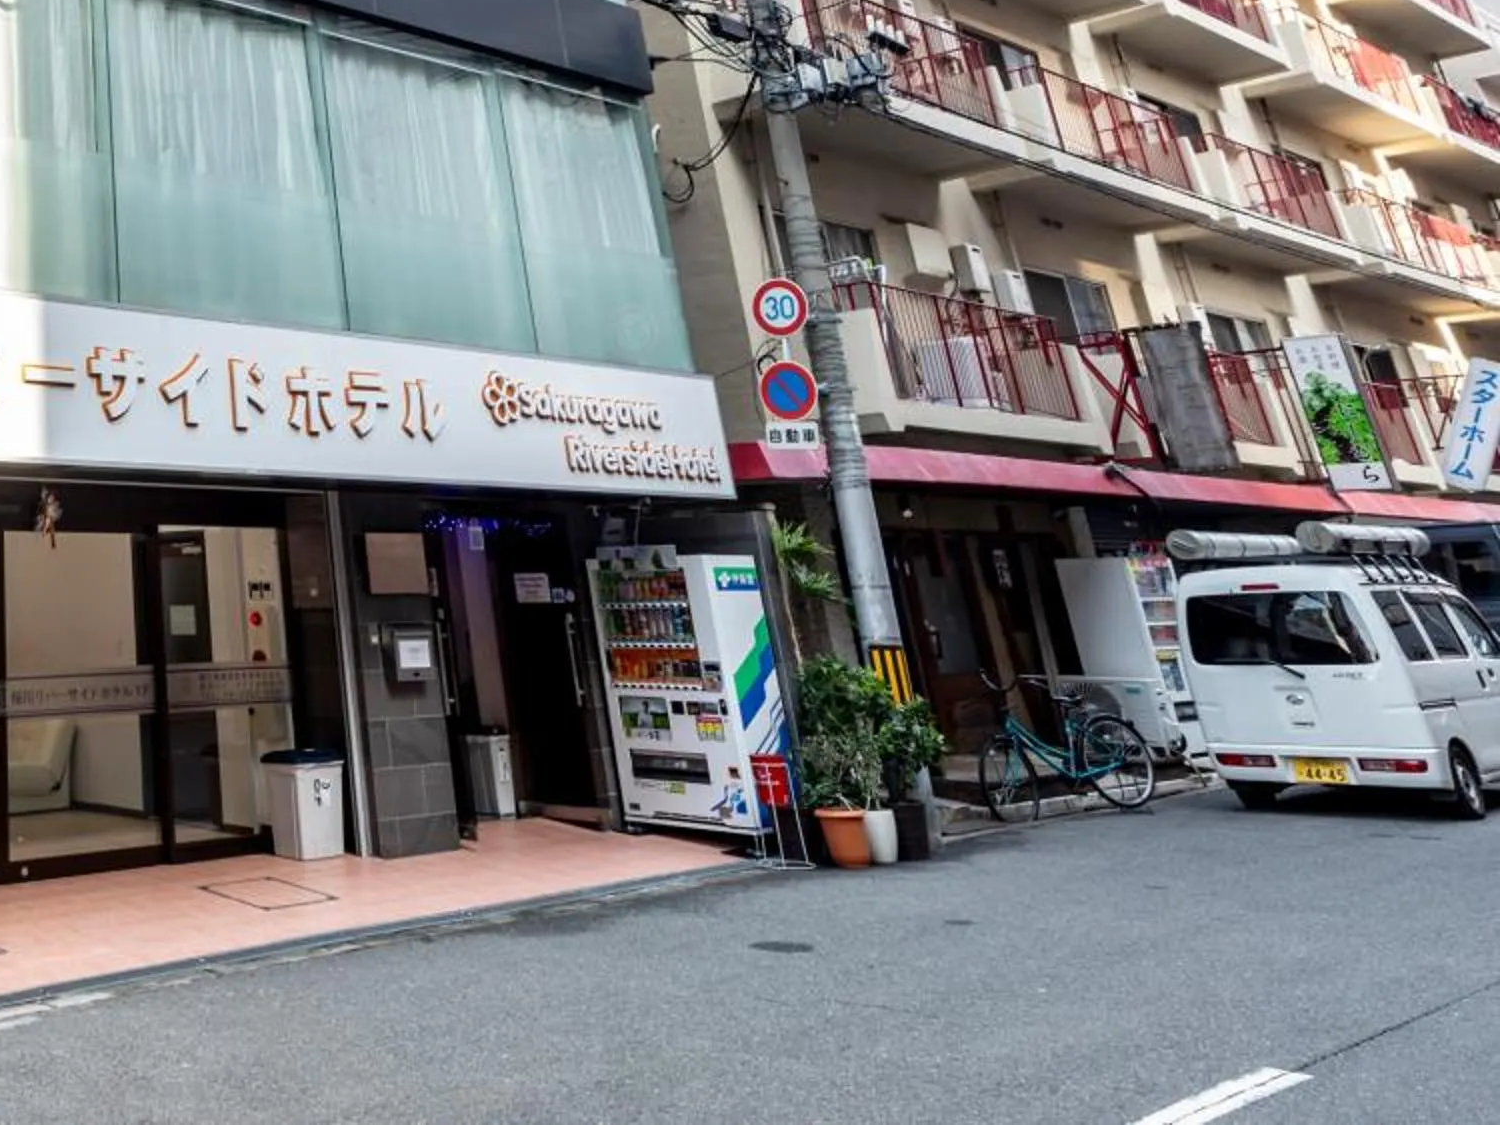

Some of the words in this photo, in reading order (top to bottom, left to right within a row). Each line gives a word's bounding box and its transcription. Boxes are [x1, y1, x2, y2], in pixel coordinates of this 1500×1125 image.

[765, 295, 796, 320] 30
[518, 383, 662, 433] Sakuragawa
[1449, 370, 1499, 480] スターホーム
[769, 428, 817, 444] 自動車
